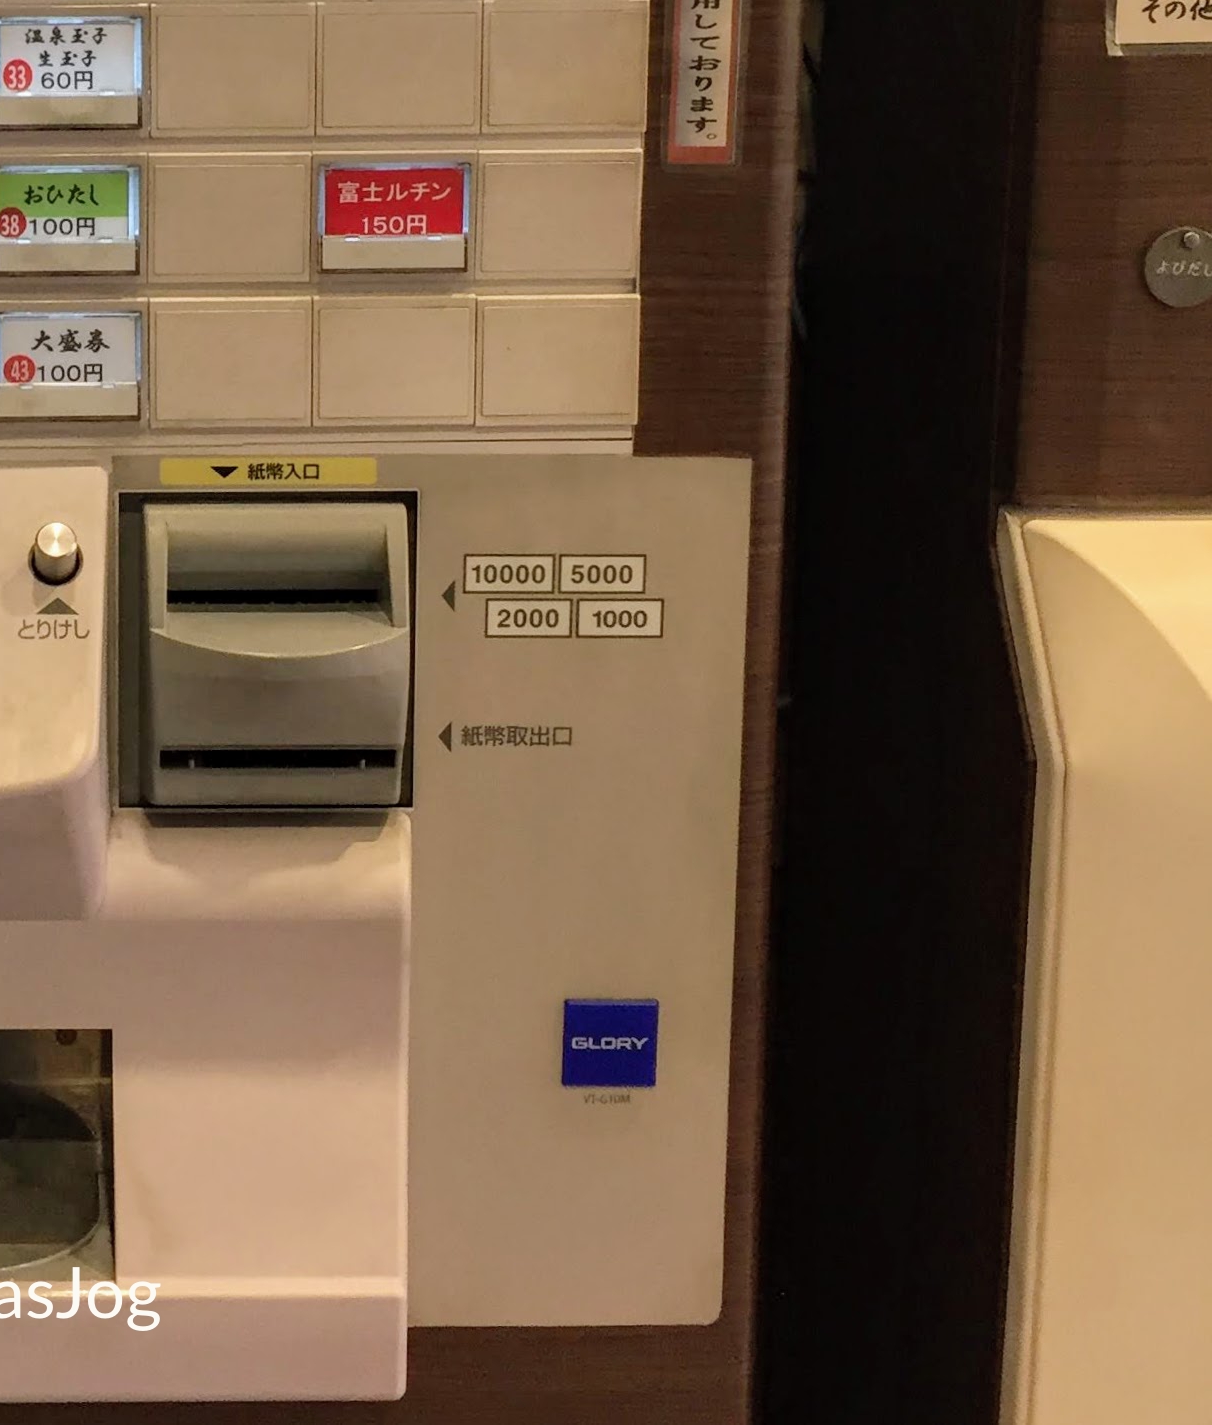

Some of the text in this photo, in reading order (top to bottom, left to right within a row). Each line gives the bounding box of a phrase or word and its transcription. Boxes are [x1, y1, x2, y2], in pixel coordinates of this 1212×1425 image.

[24, 27, 108, 45] 温泉玉子
[41, 70, 94, 90] 60円
[24, 184, 99, 207] おひたし
[338, 181, 451, 204] 富士ルチン
[28, 217, 96, 237] 100円
[362, 215, 427, 234] 150円
[36, 363, 104, 383] 100円
[248, 463, 320, 480] 紙幣入口
[471, 565, 633, 585] 10000 5000
[497, 609, 647, 628] 2000 1000
[18, 620, 90, 639] とりけし
[461, 726, 573, 747] 紙幣取出口
[572, 1037, 649, 1050] GLORY
